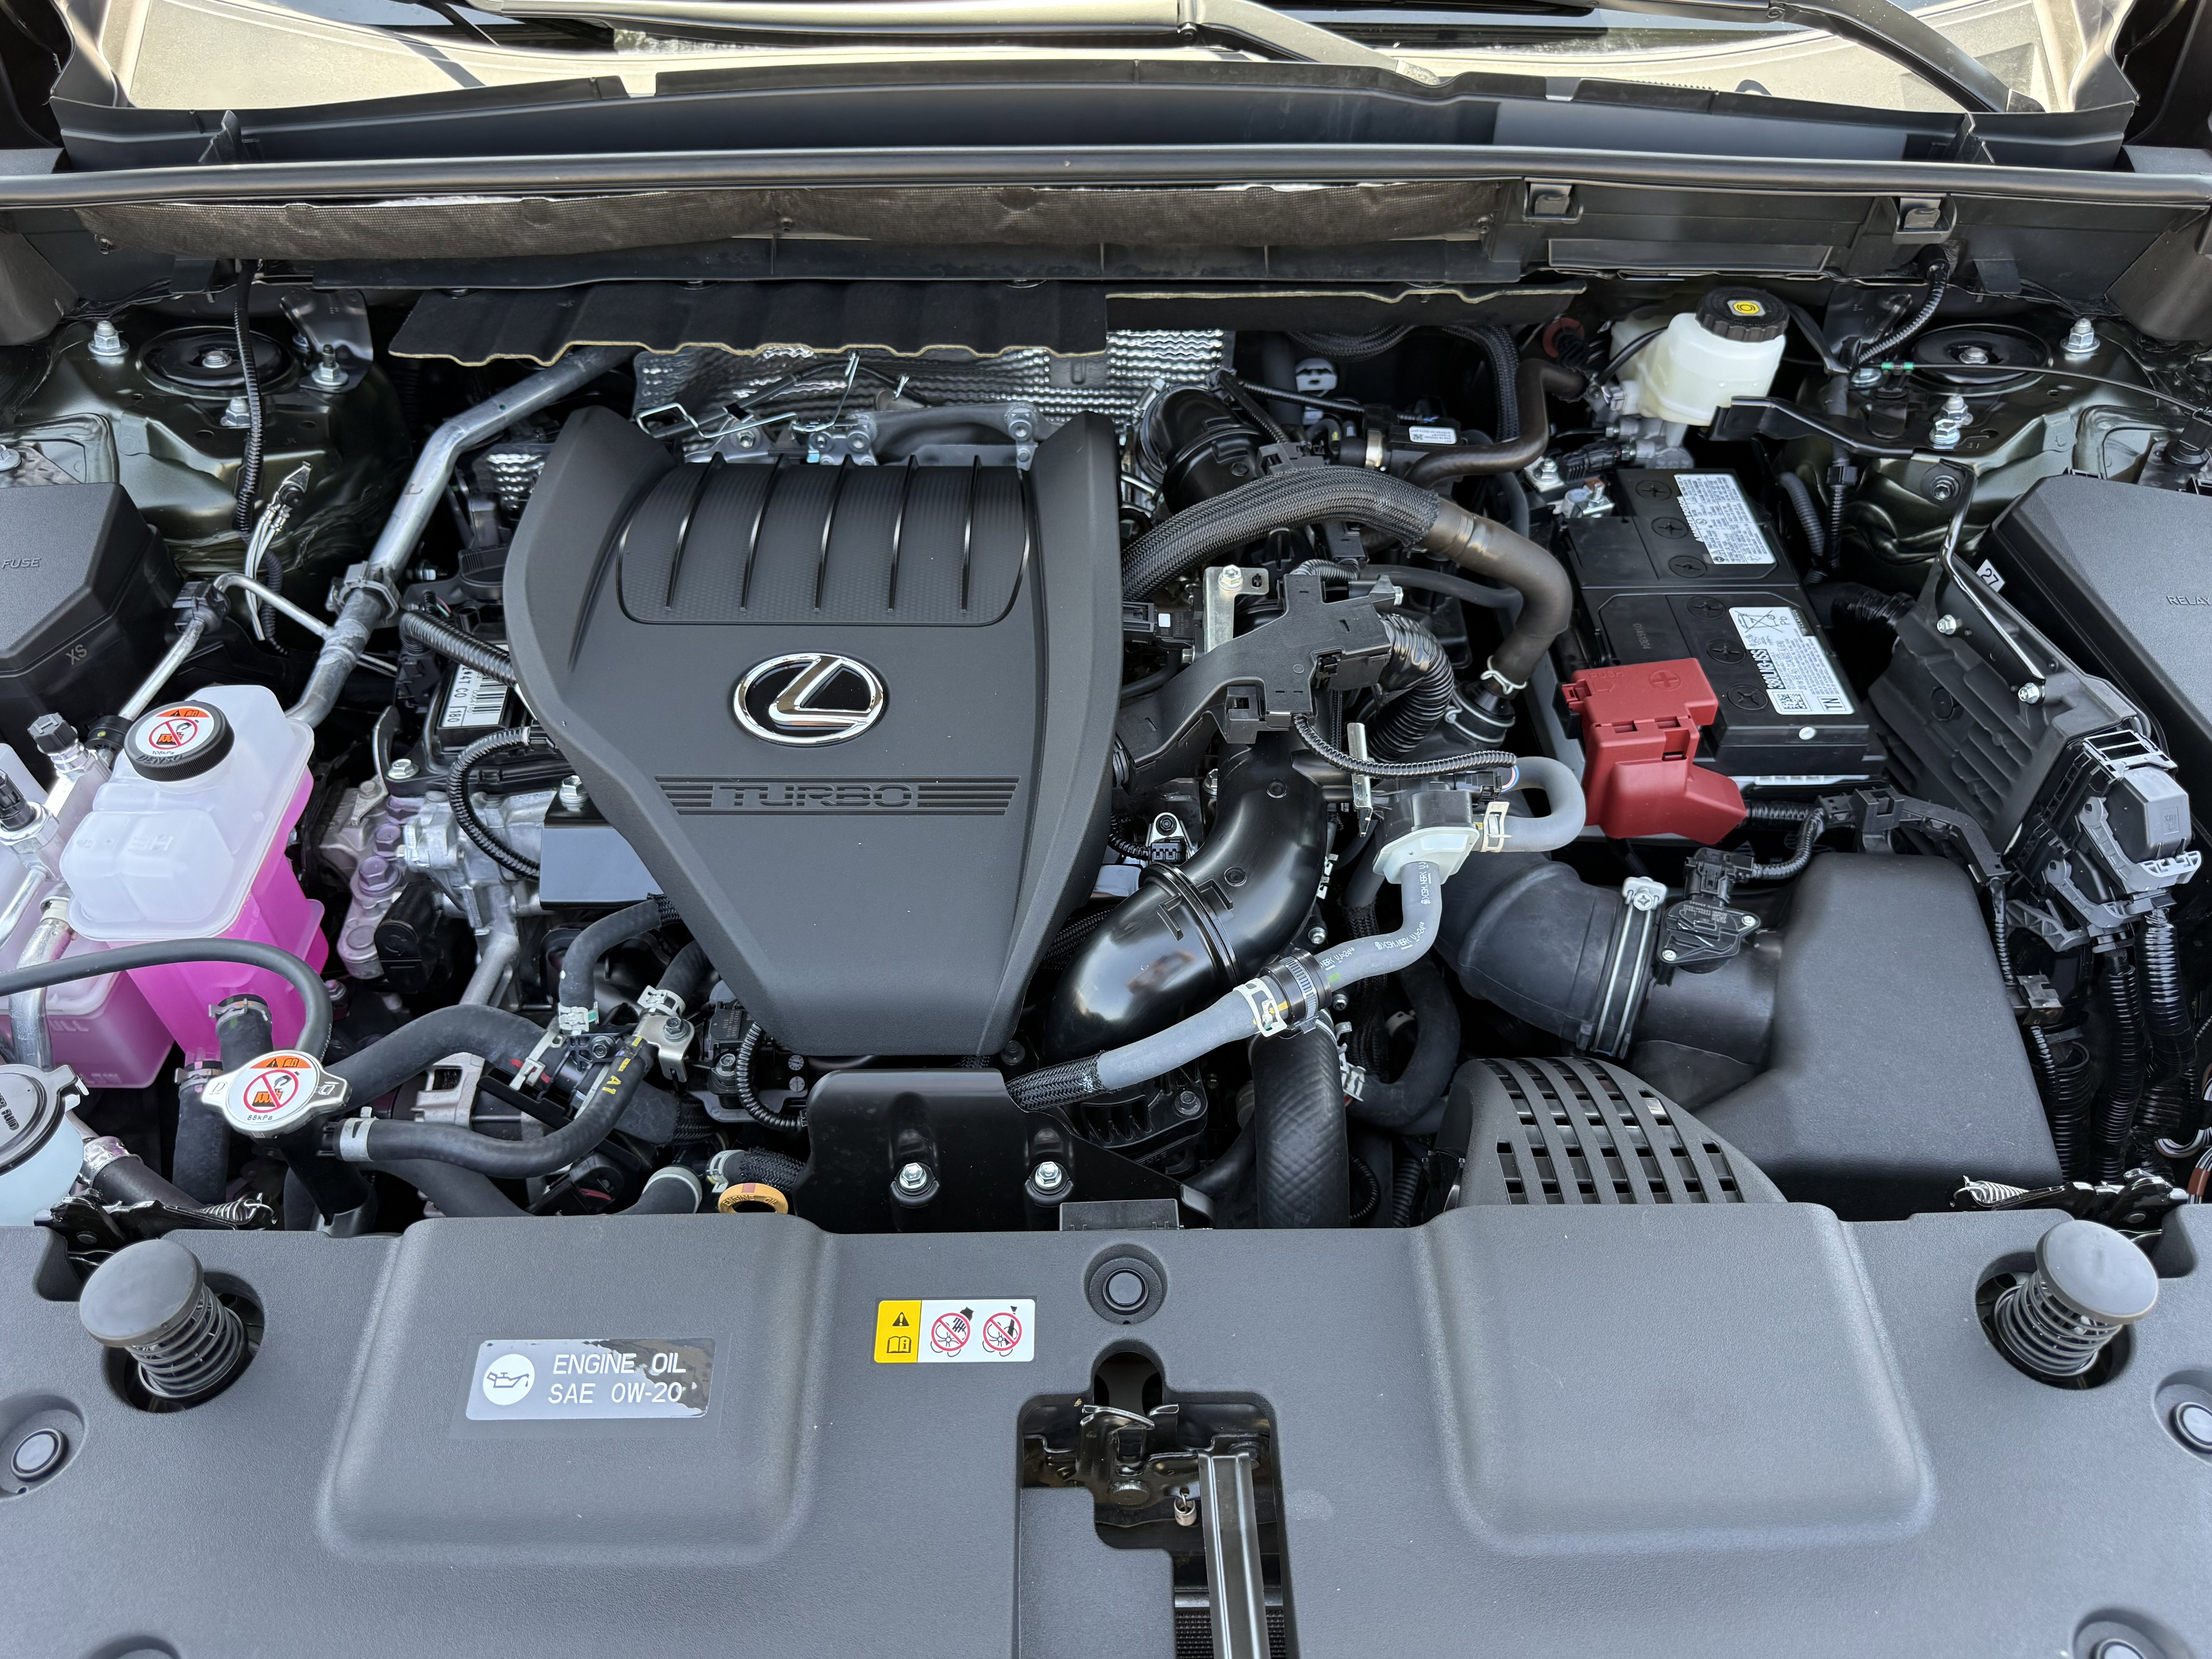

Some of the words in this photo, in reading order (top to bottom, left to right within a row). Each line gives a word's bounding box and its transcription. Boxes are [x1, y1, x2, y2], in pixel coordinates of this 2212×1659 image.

[2, 558, 41, 568] FUSE
[1981, 568, 1999, 586] 27
[2166, 594, 2212, 606] RELAY
[1780, 616, 1790, 625] Pb
[66, 644, 88, 666] XS
[1589, 671, 1623, 679] PUSH
[1750, 649, 1784, 689] 380LN3-ISS
[1821, 698, 1843, 709] TN
[447, 710, 462, 722] 180
[34, 715, 58, 734] H
[136, 755, 182, 764] DENSO
[719, 784, 913, 807] TURBO
[49, 1020, 89, 1032] ULL
[723, 1195, 755, 1206] ENGINE
[763, 1197, 777, 1206] OIL
[554, 1353, 636, 1375] ENGINE
[652, 1353, 686, 1374] OIL
[548, 1384, 594, 1404] SAE
[611, 1382, 682, 1404] 0W-20
